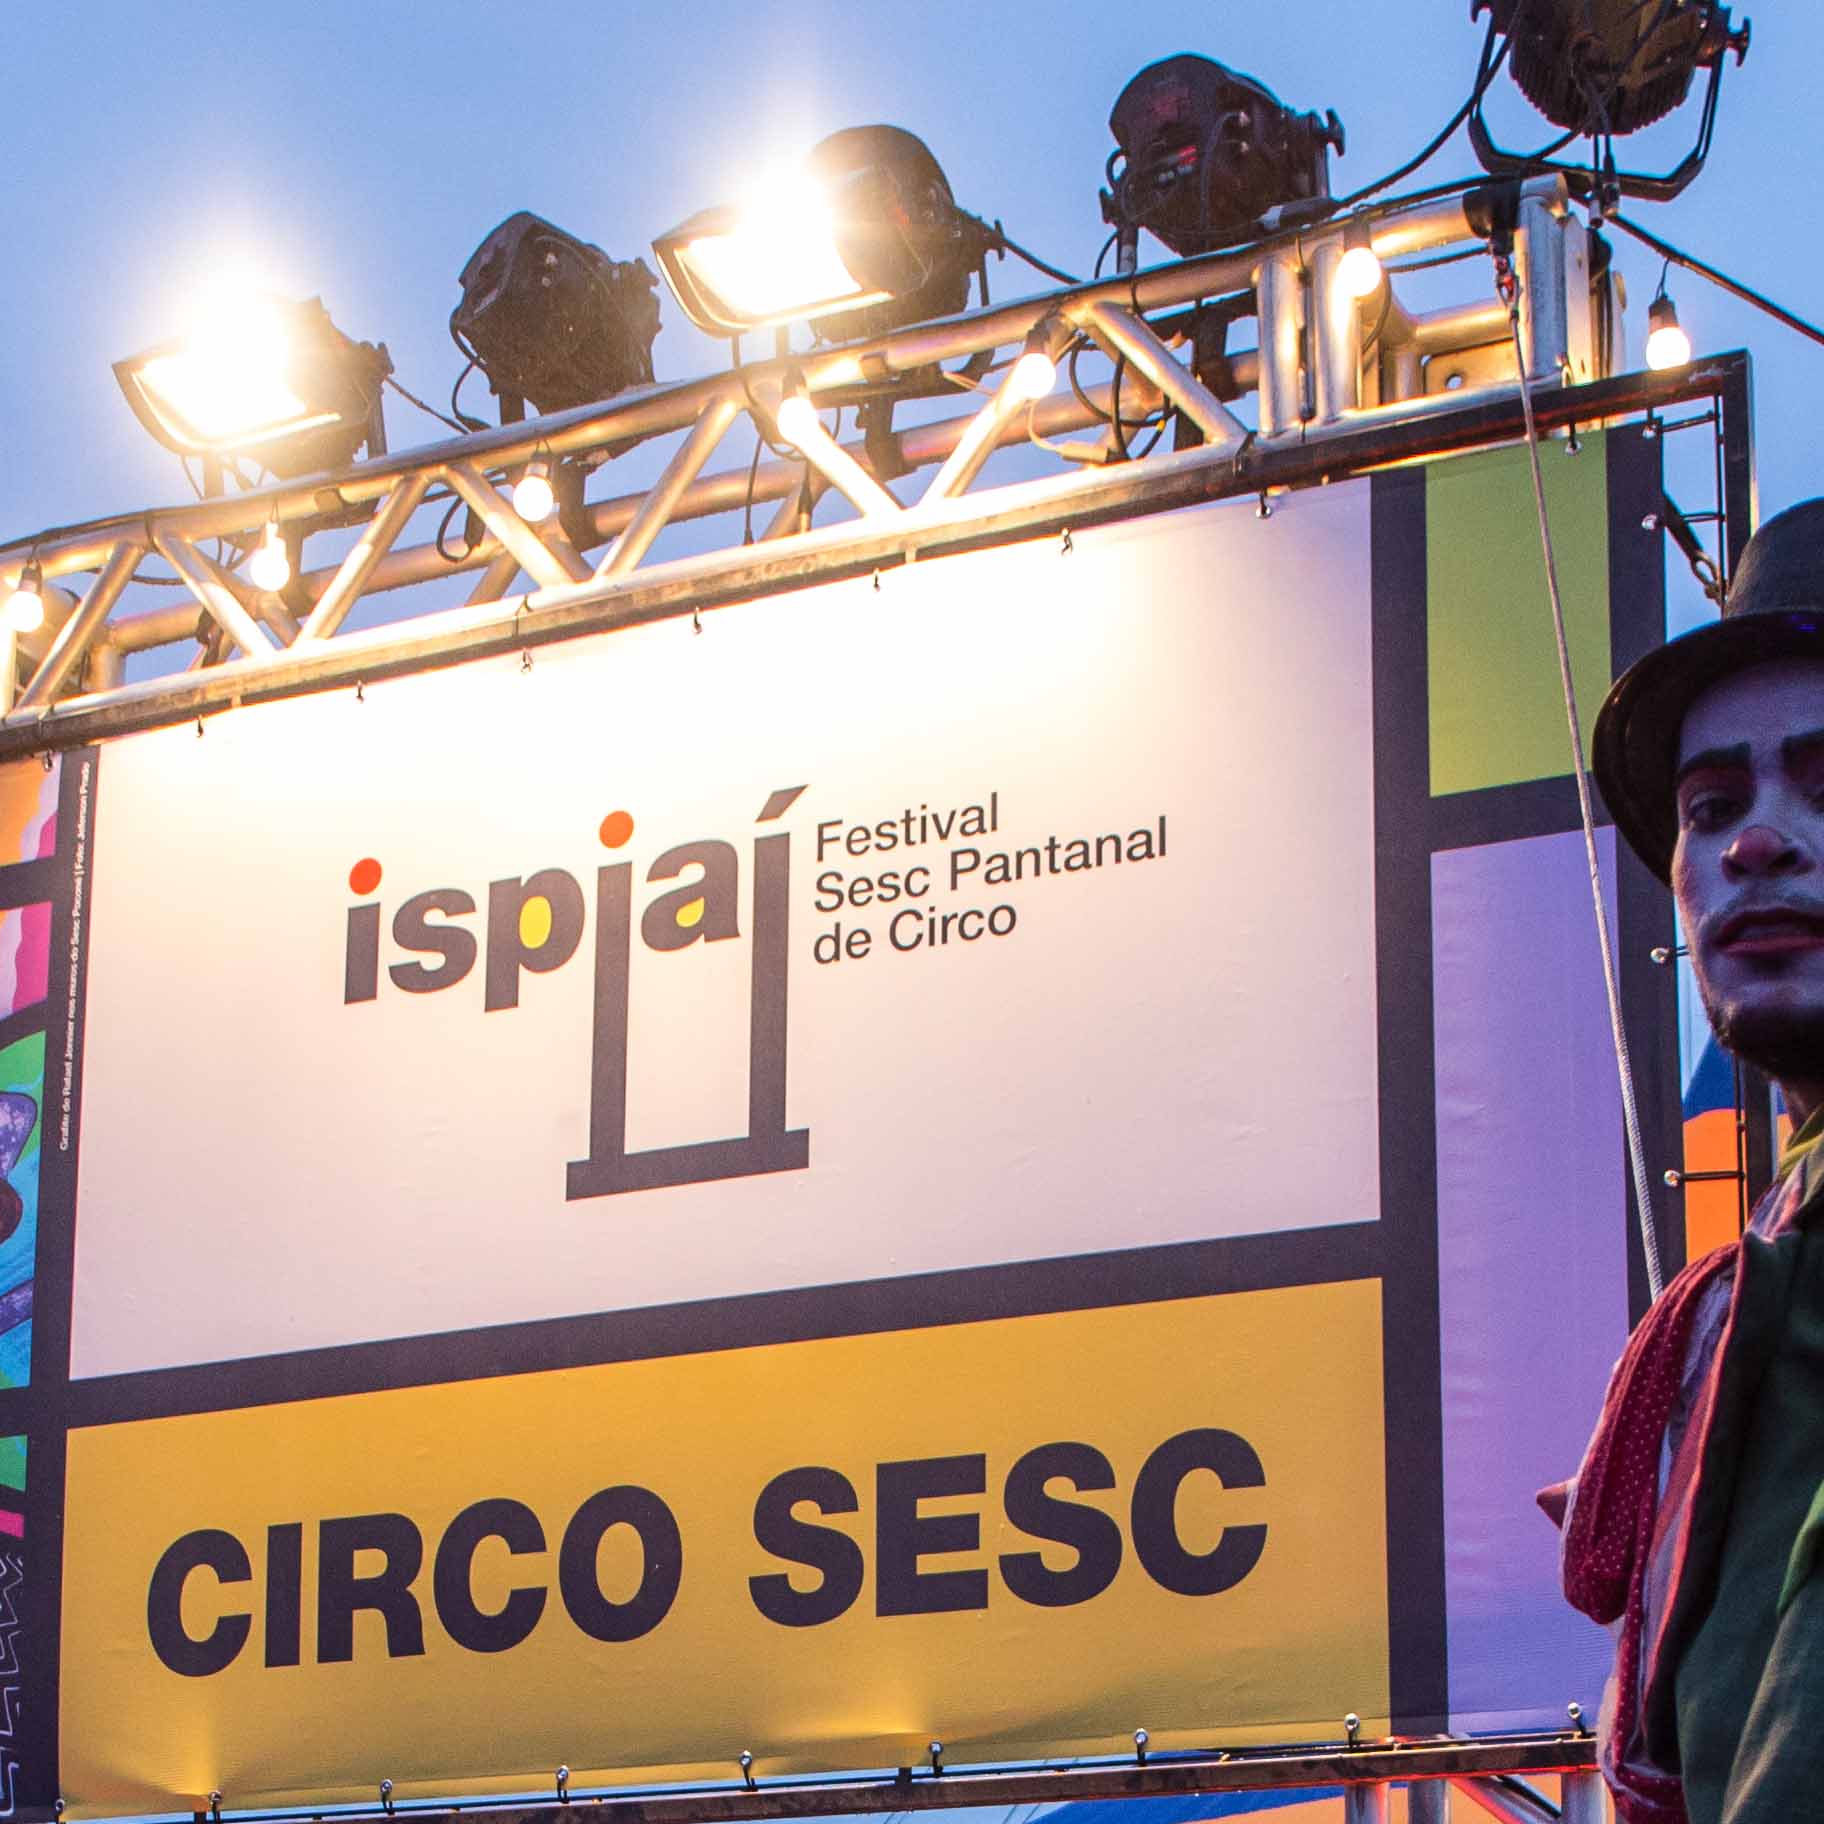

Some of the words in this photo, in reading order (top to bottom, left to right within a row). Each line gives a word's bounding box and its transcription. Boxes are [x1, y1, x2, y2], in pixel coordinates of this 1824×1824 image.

[814, 867, 930, 913] Sesc
[949, 816, 1168, 891] Pantanal
[815, 792, 999, 862] Festival
[813, 920, 873, 965] de
[888, 903, 1017, 952] Circo
[147, 1484, 683, 1679] CIRCO
[748, 1426, 1268, 1629] SESC
